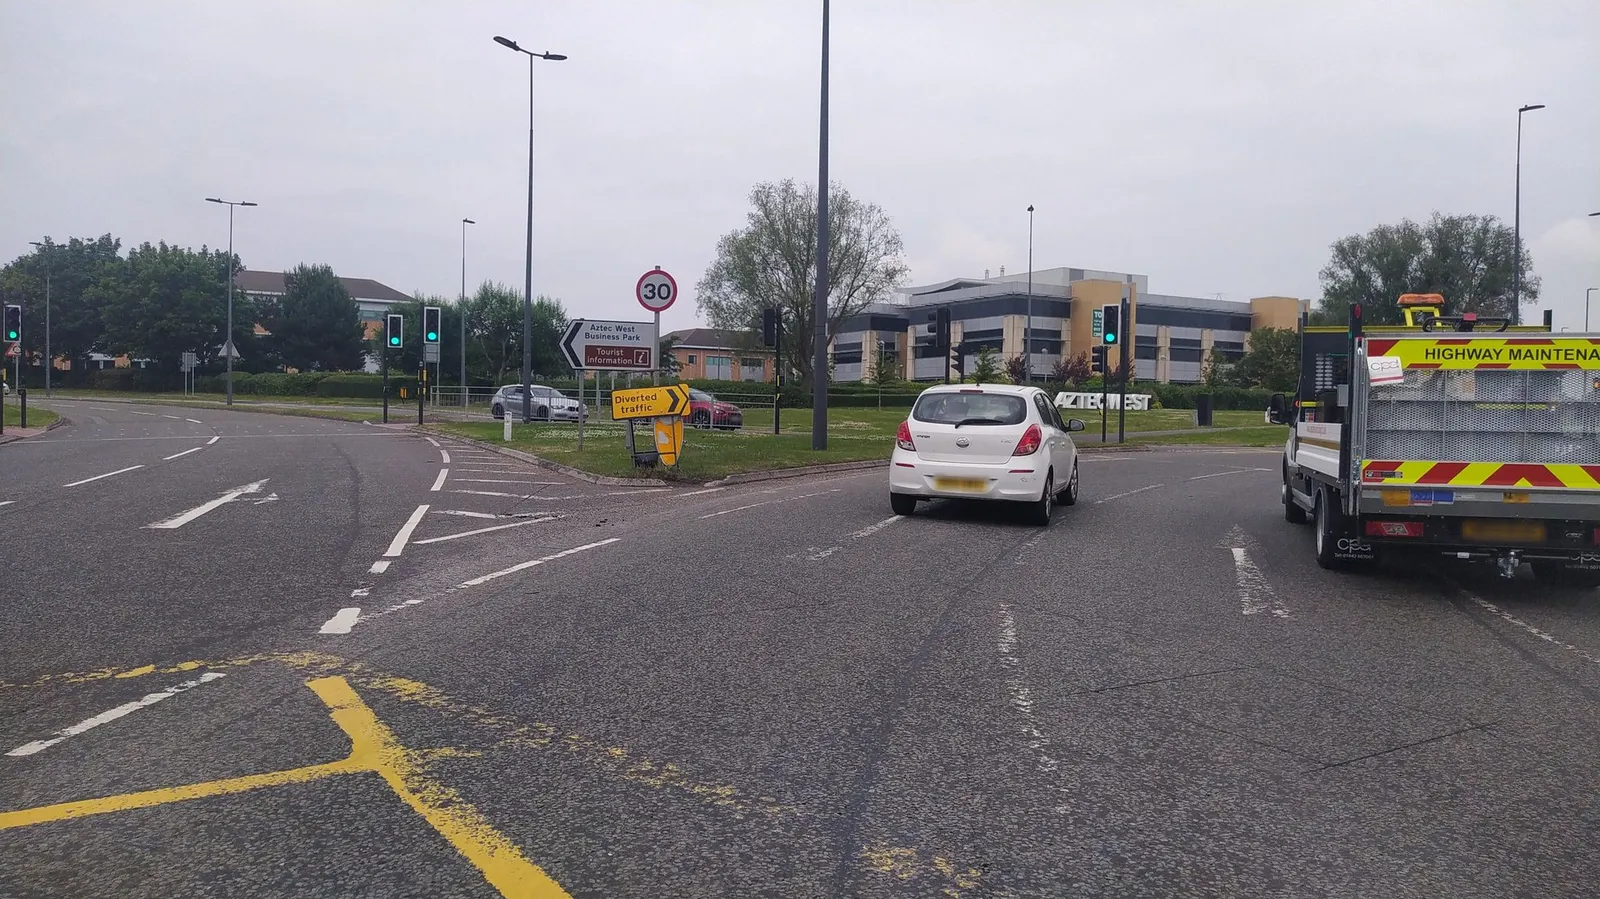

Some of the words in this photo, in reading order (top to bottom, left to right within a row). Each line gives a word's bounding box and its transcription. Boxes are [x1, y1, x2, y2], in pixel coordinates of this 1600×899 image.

[643, 283, 671, 300] 30
[590, 324, 612, 332] Aztec
[615, 325, 635, 333] West
[584, 332, 620, 341] Business
[596, 347, 624, 356] Tourist
[1424, 347, 1504, 361] HIGHWAY
[1508, 348, 1600, 361] MAINTENA
[614, 393, 657, 404] Diverted
[620, 404, 653, 414] traffic
